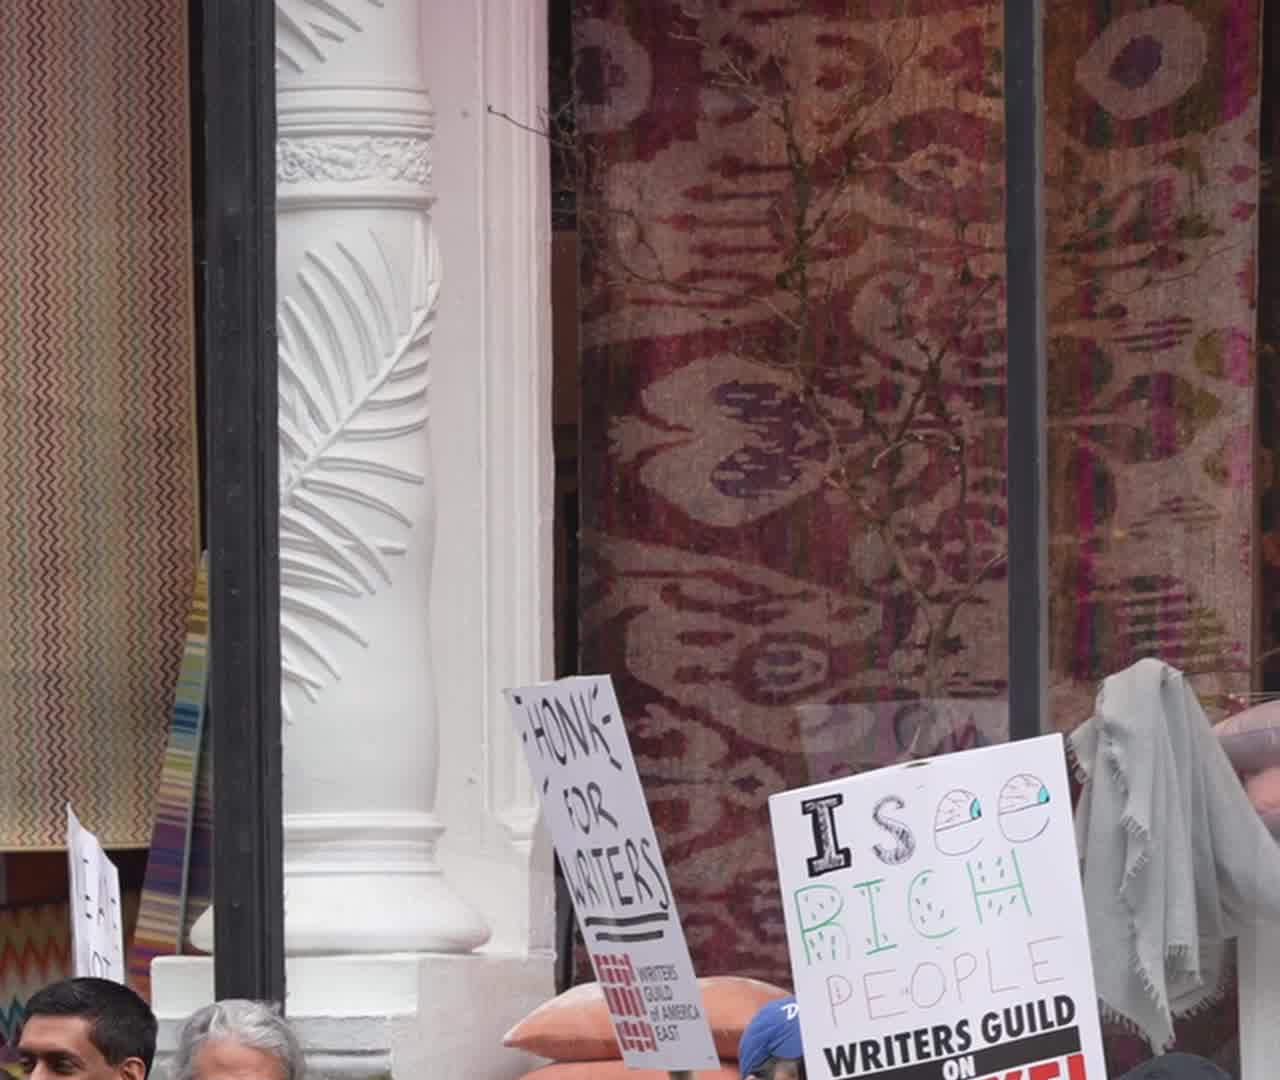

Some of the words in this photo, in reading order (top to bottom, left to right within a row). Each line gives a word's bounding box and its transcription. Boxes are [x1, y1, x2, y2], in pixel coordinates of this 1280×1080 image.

[801, 793, 852, 878] I
[794, 848, 1032, 966] RICH
[637, 964, 678, 982] WRITERS
[643, 985, 673, 1003] GUILD
[825, 936, 1065, 1028] PEOPLE
[655, 1025, 680, 1042] EAST
[661, 1004, 700, 1021] AMERICA
[824, 1018, 971, 1078] WRITERS
[981, 994, 1076, 1044] GUILD
